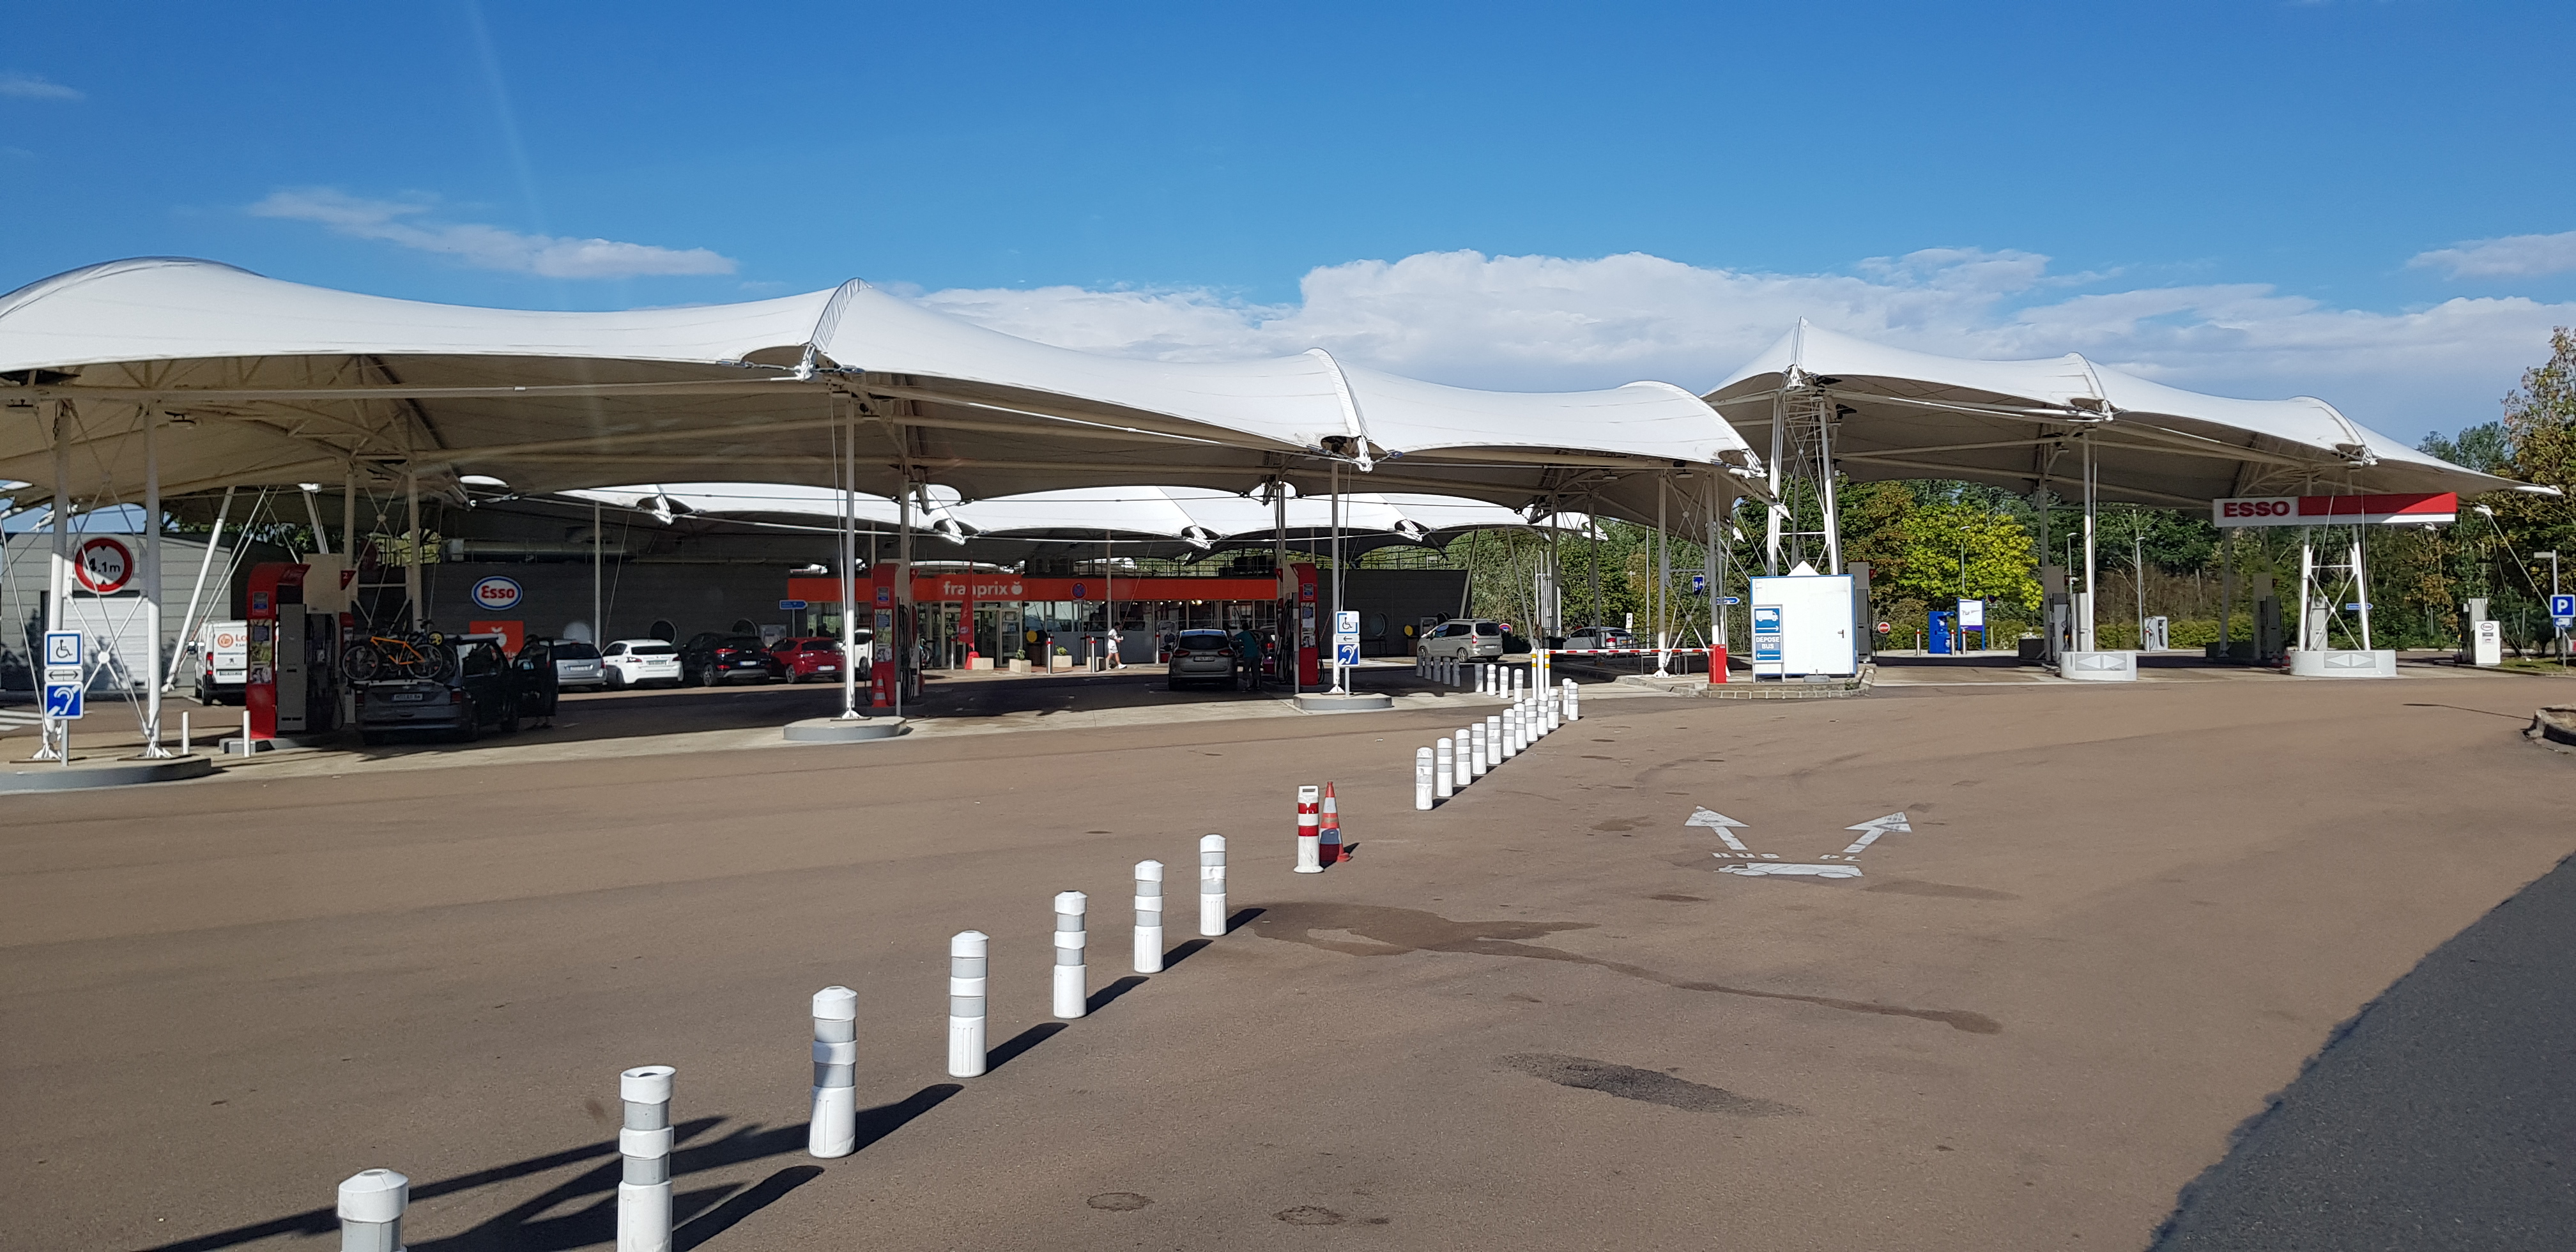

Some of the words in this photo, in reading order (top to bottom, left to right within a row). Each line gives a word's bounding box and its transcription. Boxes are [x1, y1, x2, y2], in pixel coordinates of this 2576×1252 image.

[2224, 501, 2290, 517] ESSO
[481, 585, 515, 599] Esso
[2557, 599, 2568, 613] P
